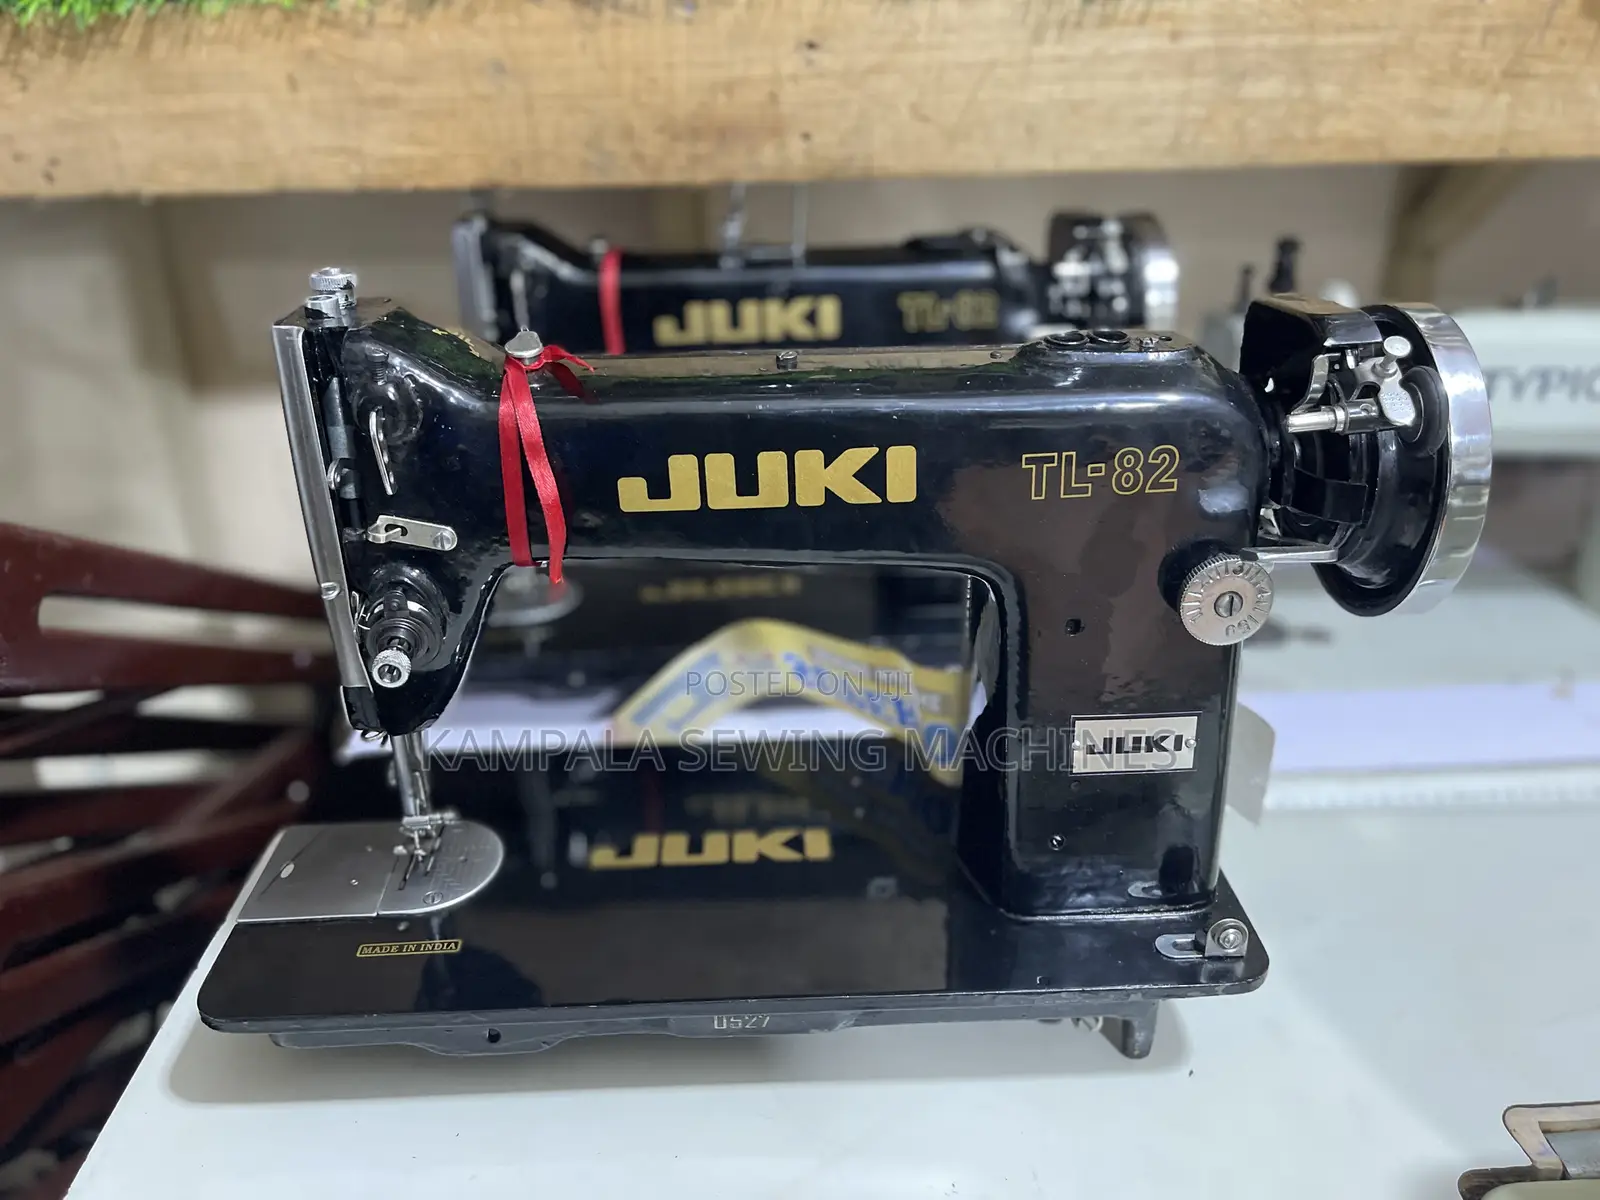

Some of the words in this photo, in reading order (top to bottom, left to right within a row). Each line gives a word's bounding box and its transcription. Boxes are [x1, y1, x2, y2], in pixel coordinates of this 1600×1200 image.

[653, 295, 841, 346] JUKI
[617, 445, 917, 512] JUKI
[1022, 445, 1180, 500] TL-82
[1086, 734, 1183, 755] JUKI
[590, 828, 831, 869] JUKI
[361, 945, 399, 954] MADE
[402, 944, 416, 952] IN
[420, 942, 456, 951] INDIA
